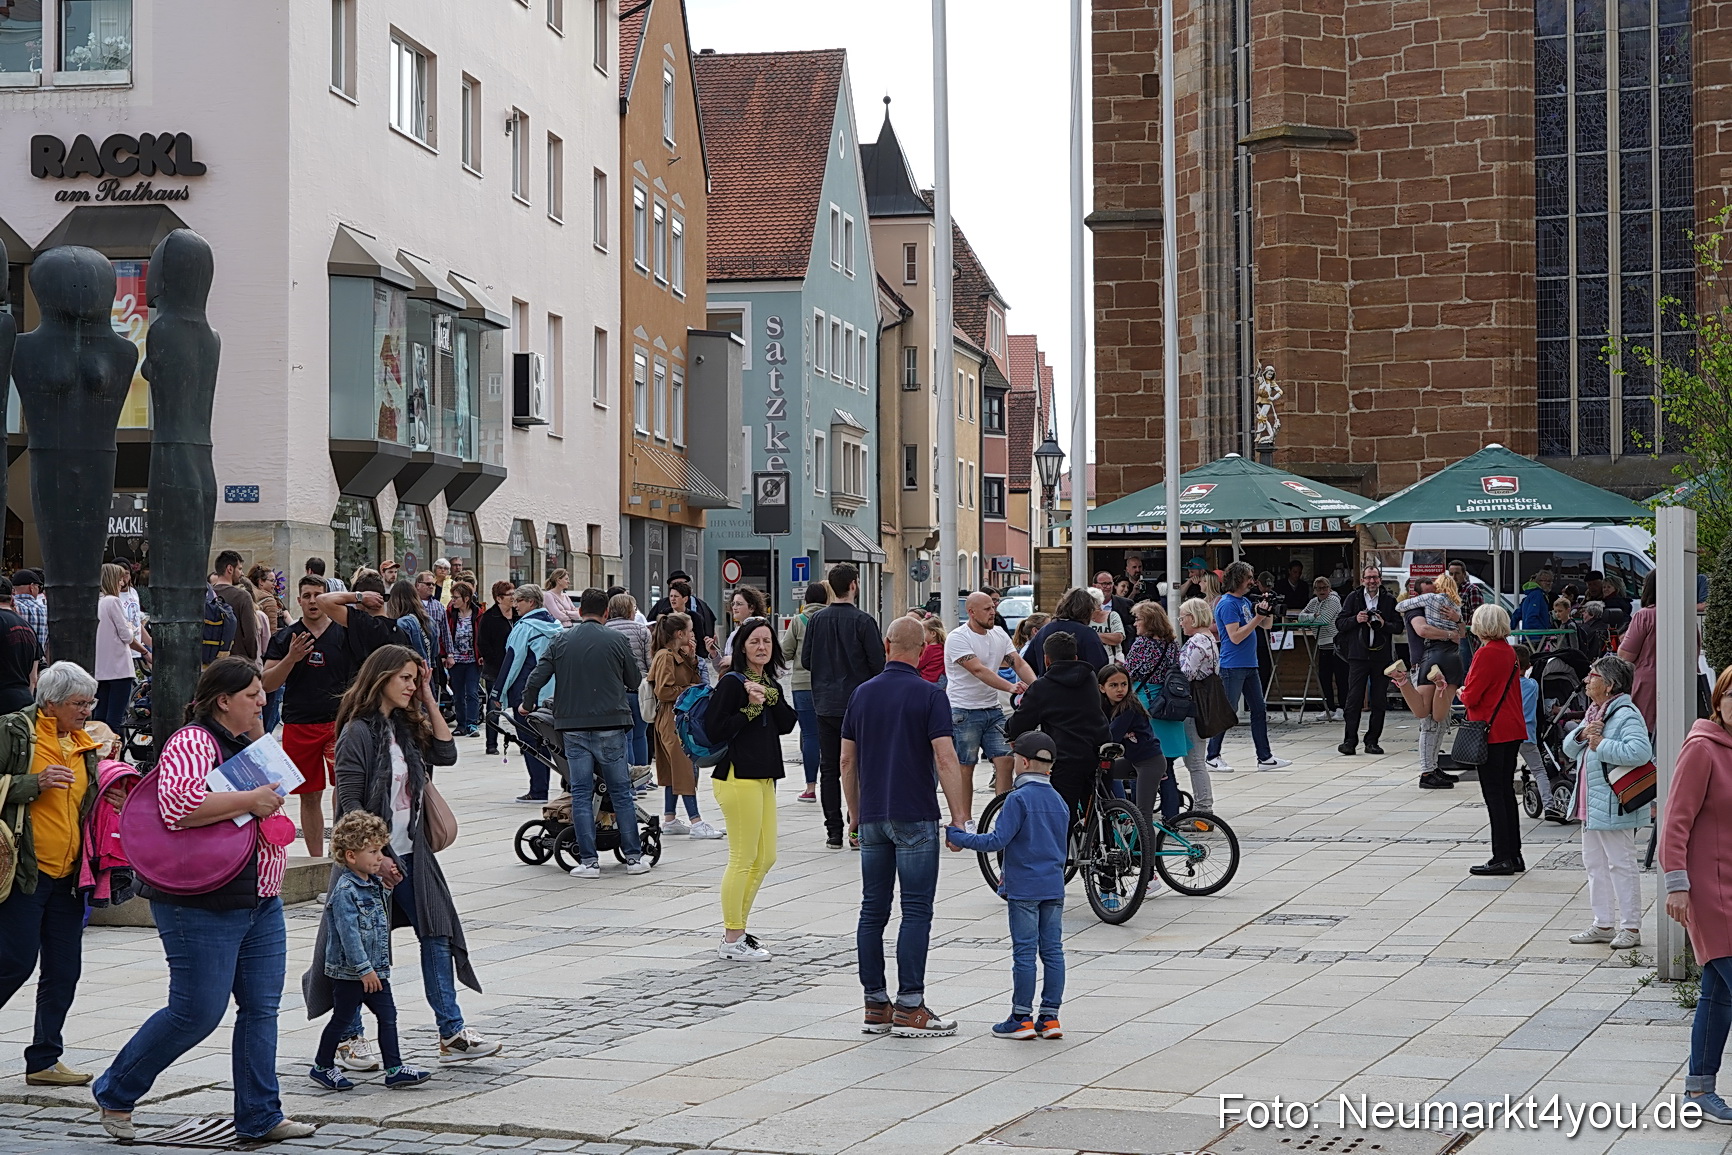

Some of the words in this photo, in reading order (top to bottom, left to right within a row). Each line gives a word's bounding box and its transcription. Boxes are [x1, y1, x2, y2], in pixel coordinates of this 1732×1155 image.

[31, 132, 207, 178] RACKL
[55, 189, 91, 202] am
[95, 178, 190, 202] Rathaus
[764, 315, 790, 471] satzke
[1153, 503, 1210, 511] Nearkter
[1456, 503, 1553, 513] Lammsbräu
[1467, 497, 1538, 505] Neumarkter
[1137, 508, 1214, 517] Lamsbräu
[283, 758, 302, 783] POOLFILTER
